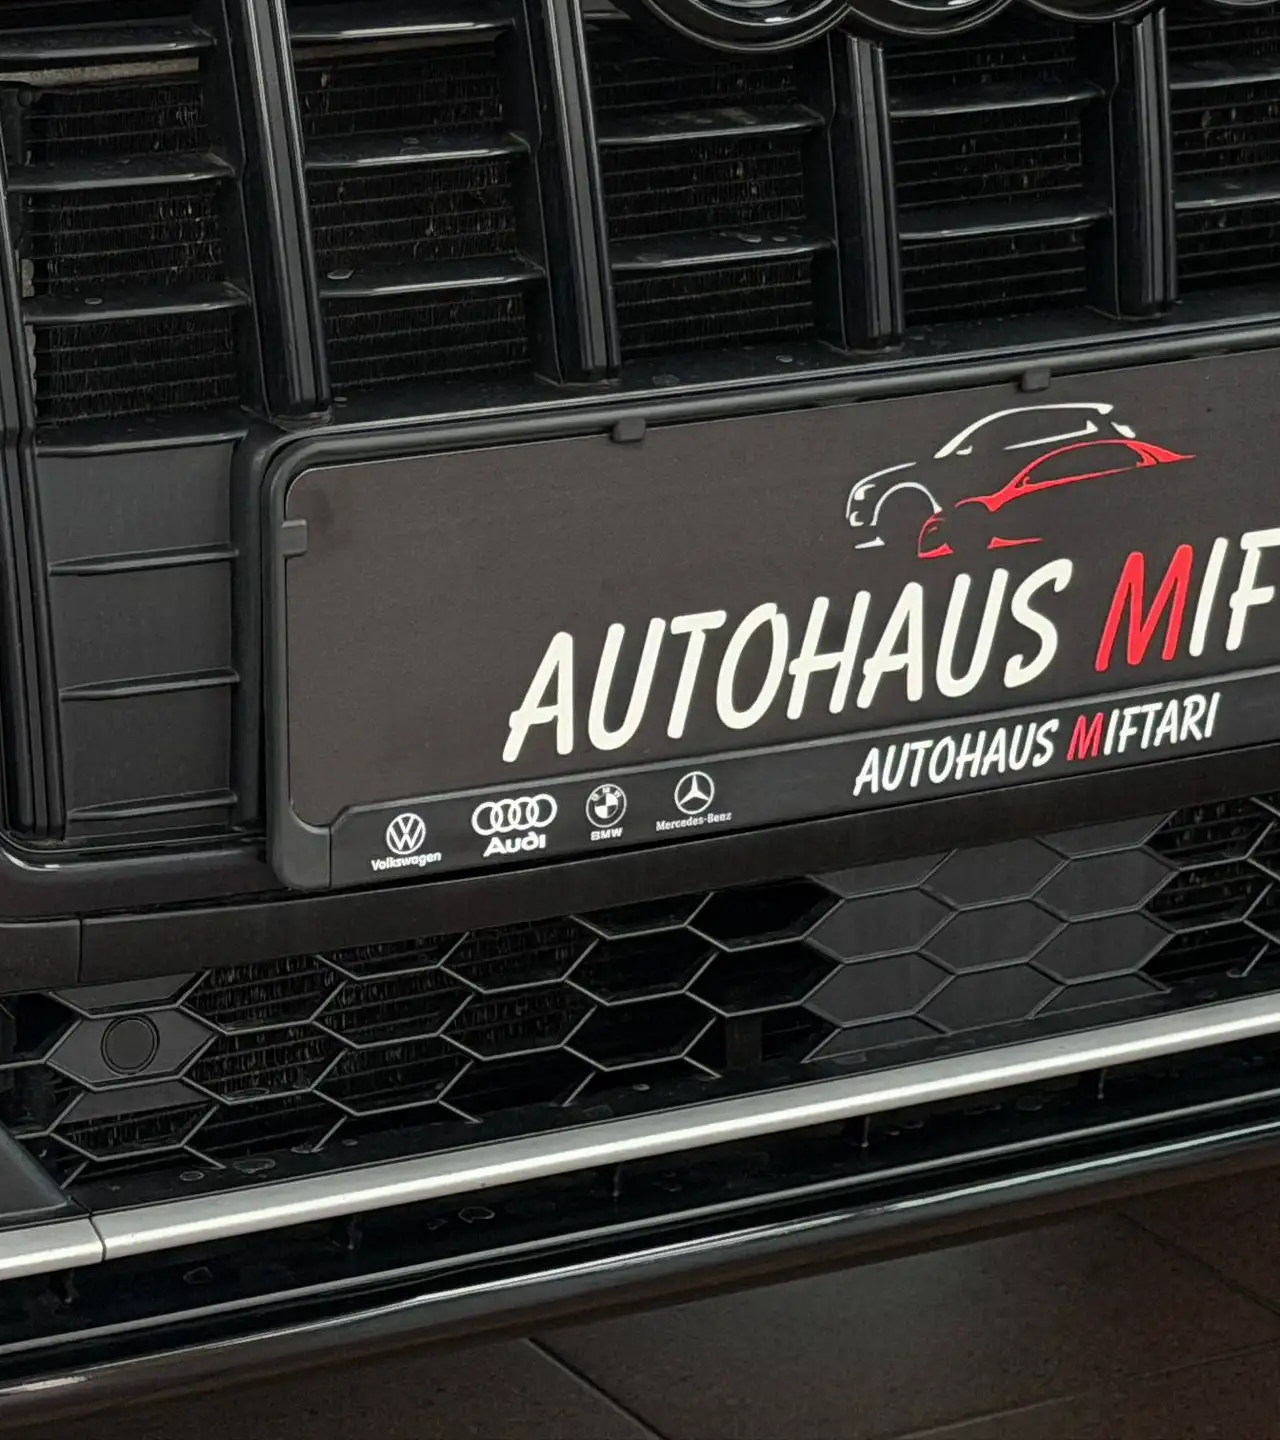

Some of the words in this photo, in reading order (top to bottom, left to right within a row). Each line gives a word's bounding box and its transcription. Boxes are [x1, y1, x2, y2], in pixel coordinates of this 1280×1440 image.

[502, 558, 1074, 763] AUTOHAUS
[853, 718, 1060, 796] AUTOHAUS
[1066, 692, 1221, 760] MIFTARI
[655, 810, 732, 833] Mercedes-Benz
[483, 834, 548, 857] Audi
[590, 826, 624, 842] BMW
[371, 850, 442, 872] Volkswagen
